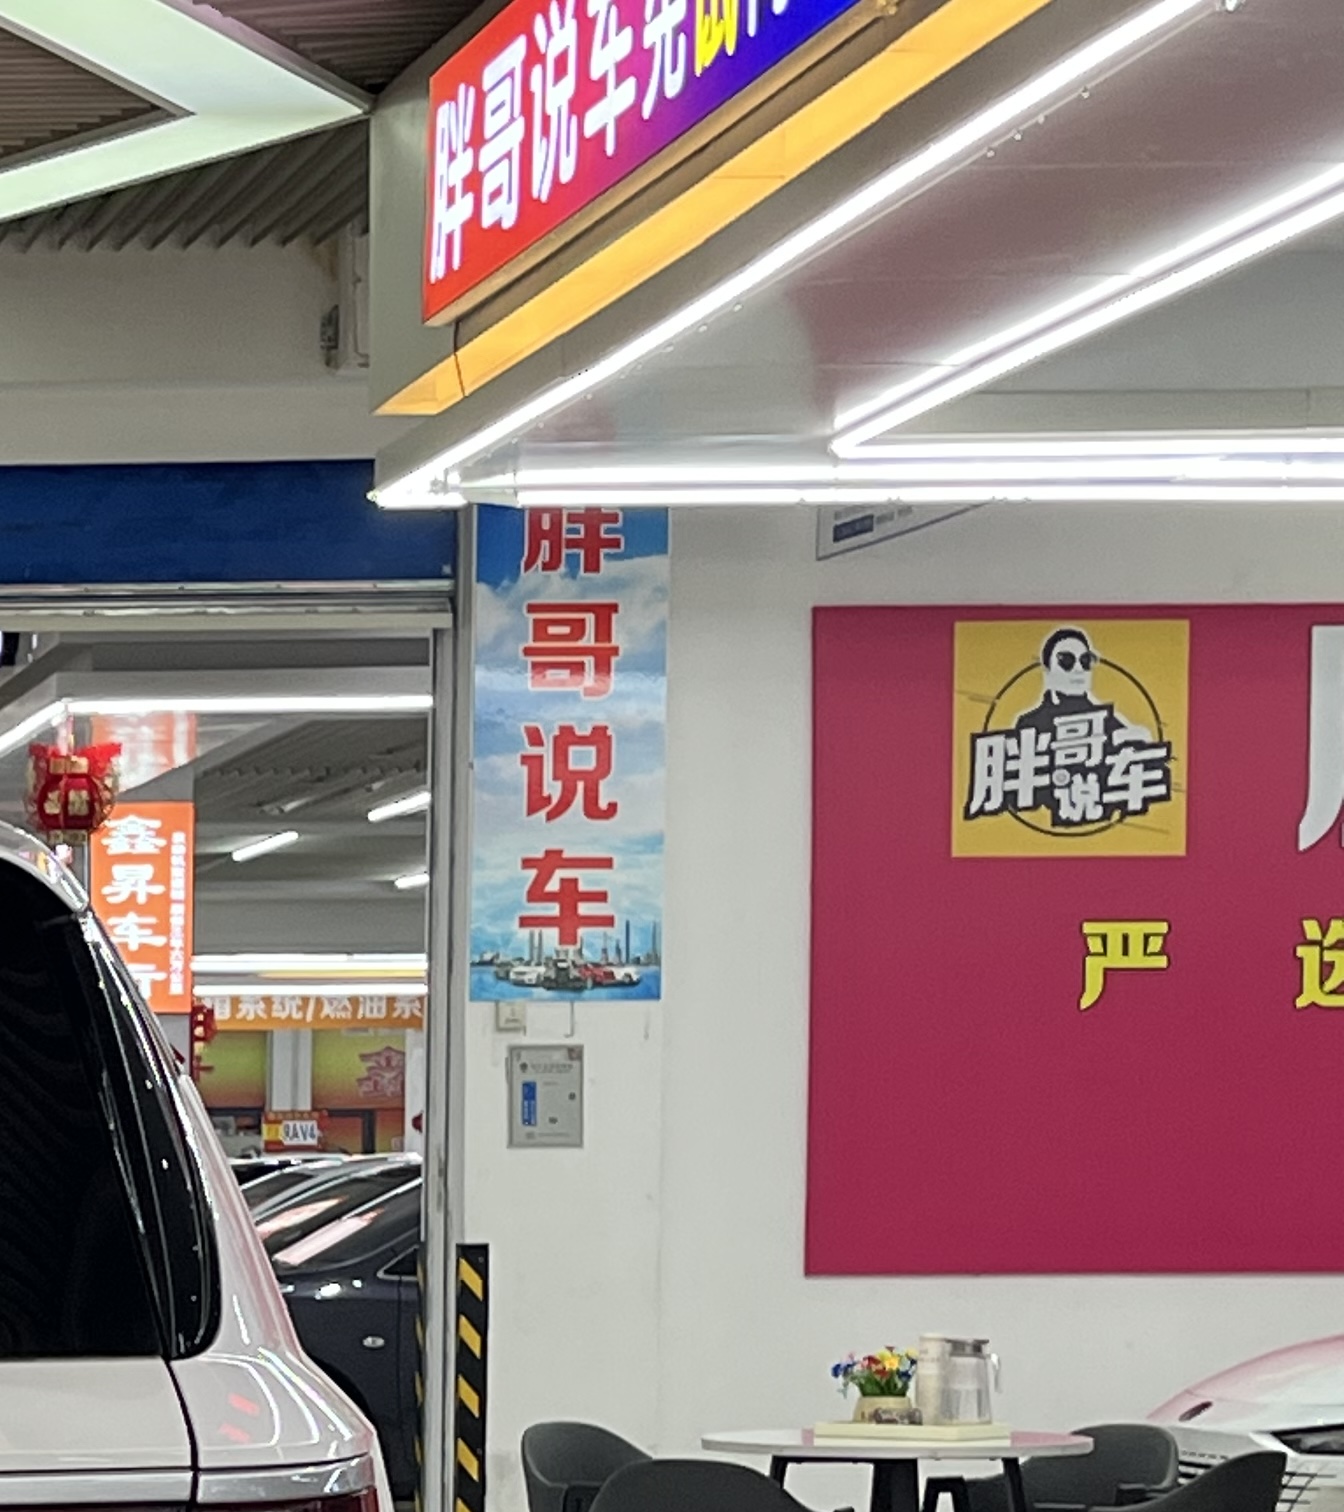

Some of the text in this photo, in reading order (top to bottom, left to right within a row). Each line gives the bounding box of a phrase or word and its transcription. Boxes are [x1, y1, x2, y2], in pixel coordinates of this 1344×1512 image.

[518, 506, 623, 947] 胖哥说车
[969, 711, 1171, 823] 胖哥说车
